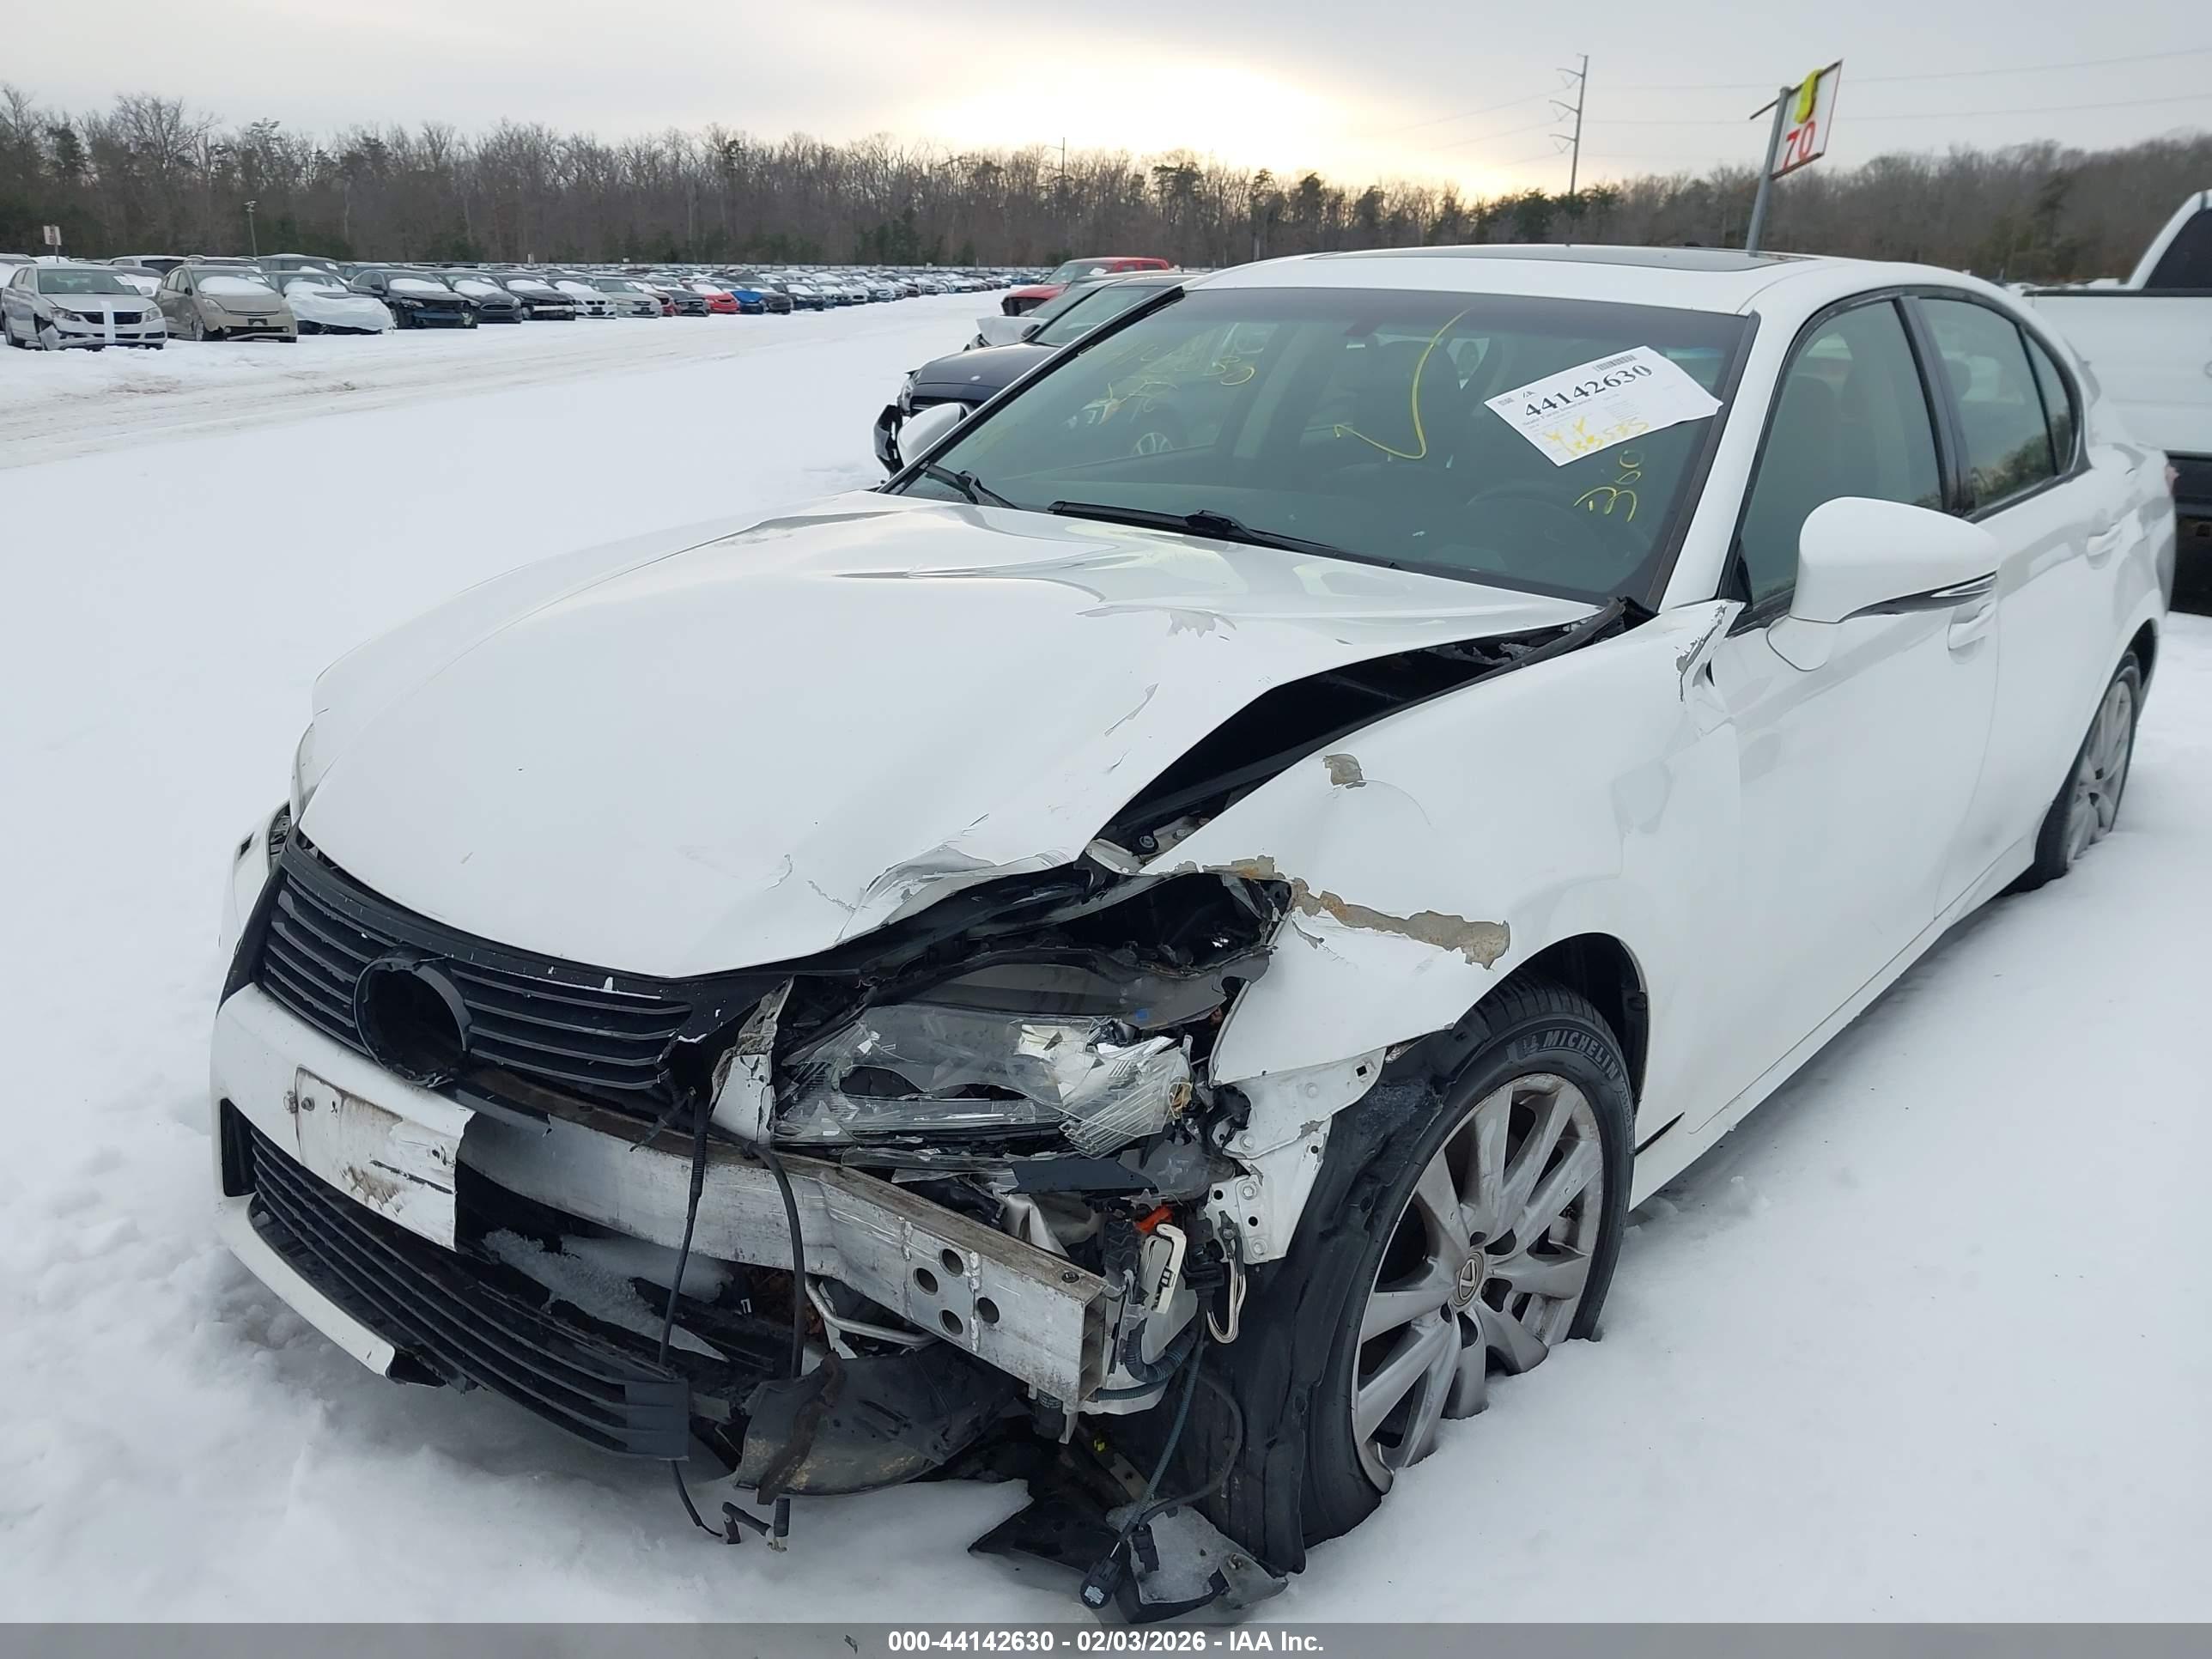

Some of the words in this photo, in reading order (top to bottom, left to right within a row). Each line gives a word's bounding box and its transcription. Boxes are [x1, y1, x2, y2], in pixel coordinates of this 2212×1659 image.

[1782, 119, 1816, 170] 70
[1525, 364, 1653, 416] 44142630
[1542, 1030, 1620, 1080] MICHELIN
